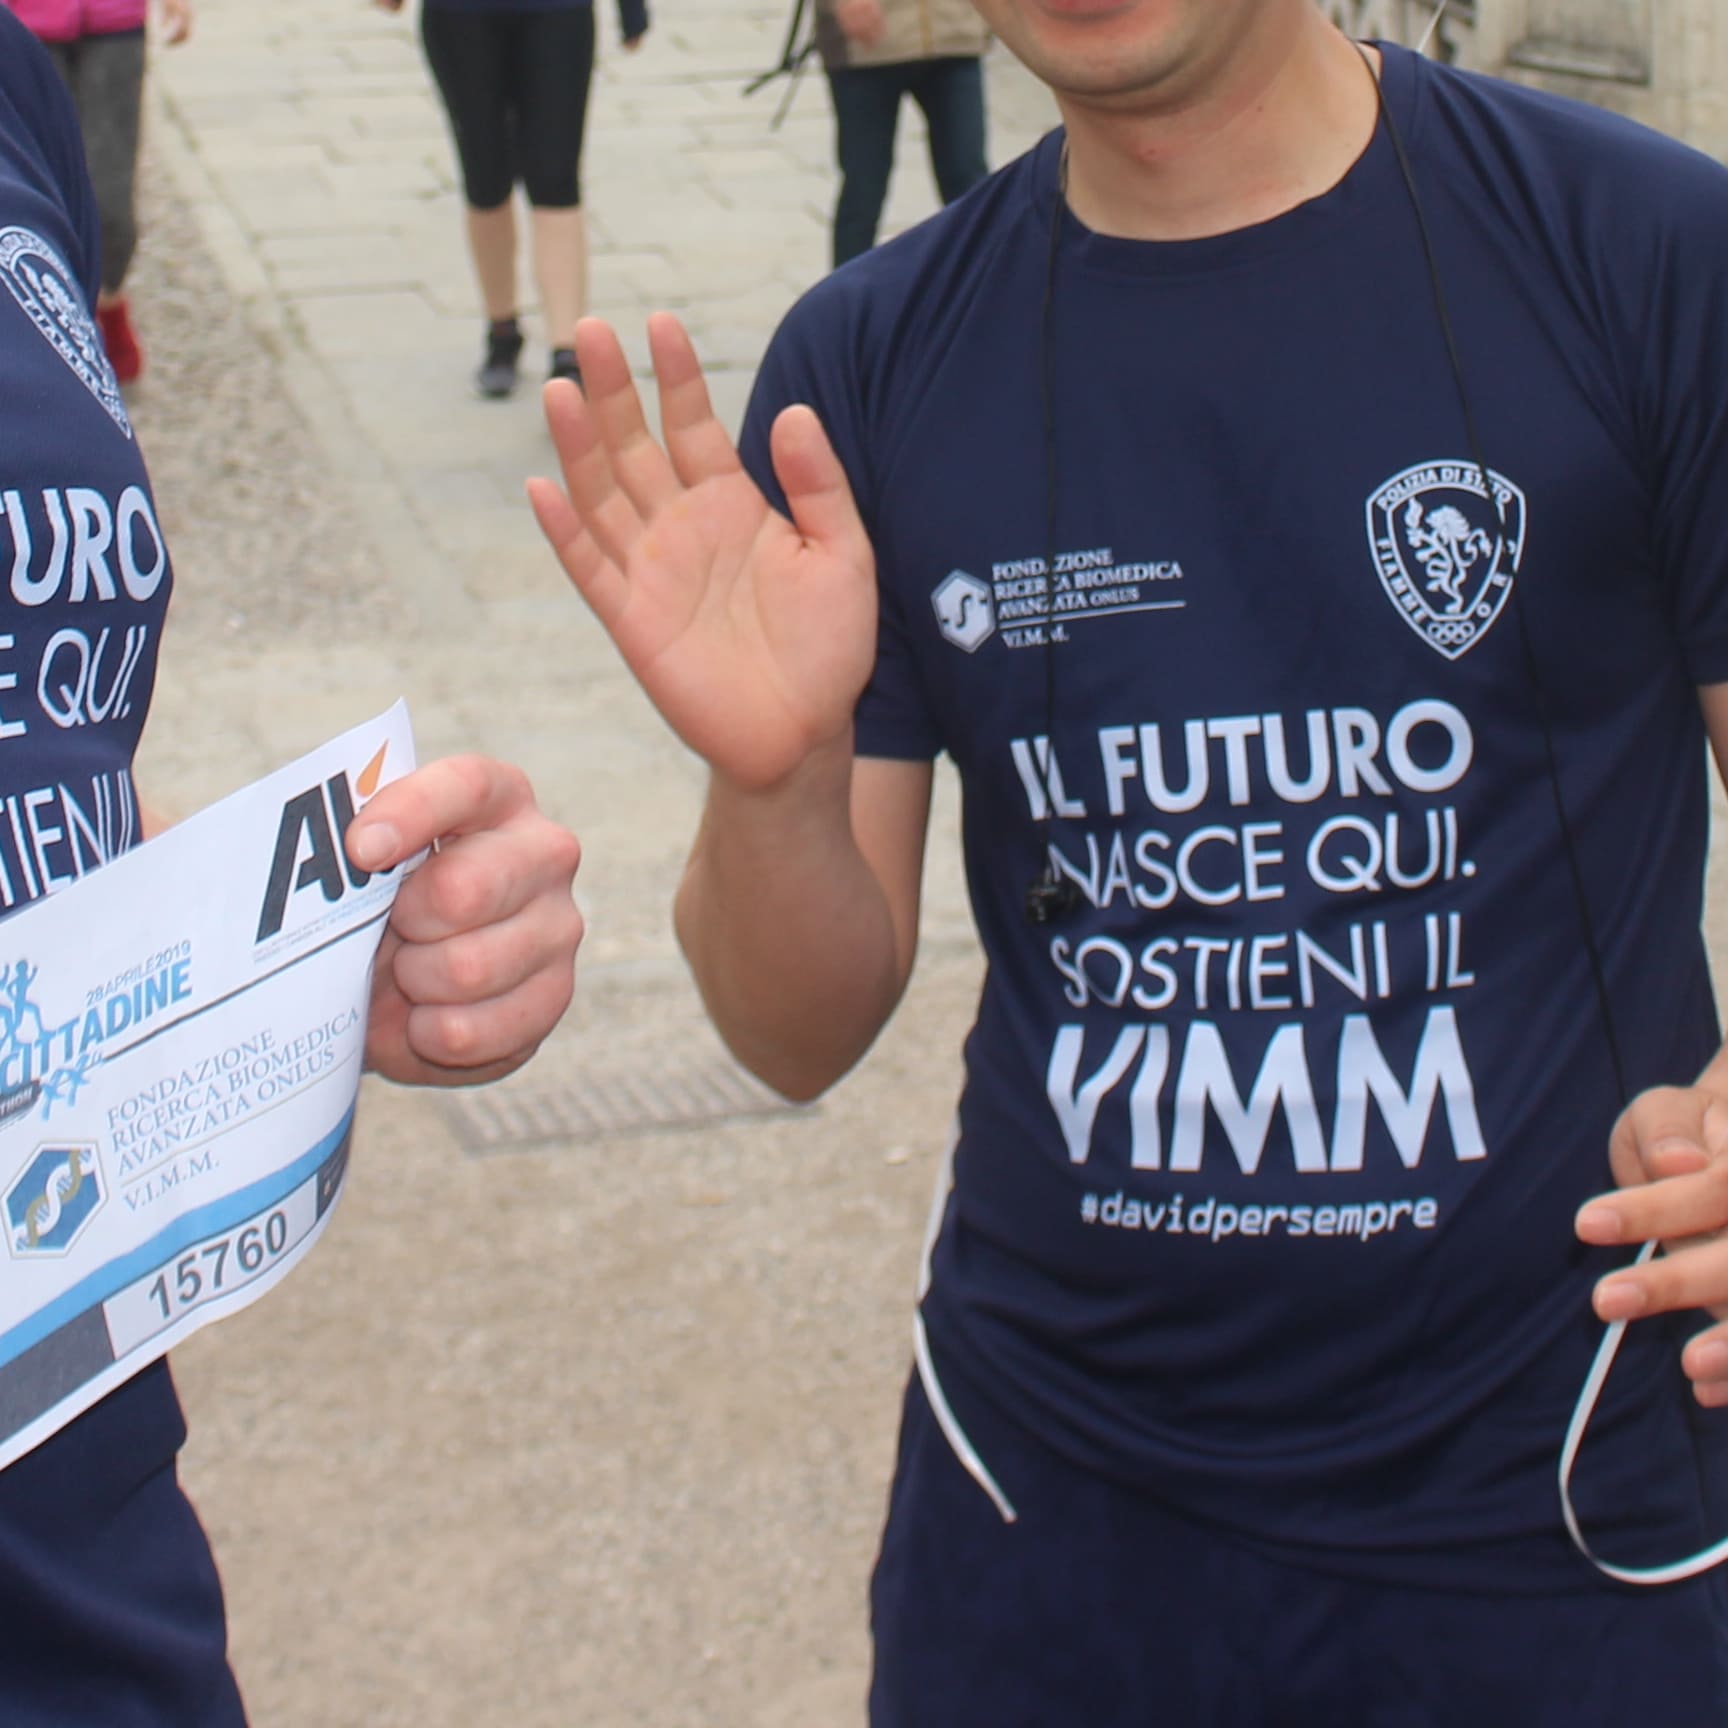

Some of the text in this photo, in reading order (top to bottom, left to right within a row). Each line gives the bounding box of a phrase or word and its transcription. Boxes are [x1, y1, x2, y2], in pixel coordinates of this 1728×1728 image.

[1377, 467, 1513, 512] POLIZIA DI STTO
[992, 547, 1114, 581] FONDZIONE
[1074, 561, 1183, 589] BIOMEDICA
[37, 626, 146, 728] QUI.
[1010, 697, 1473, 821] IL FUTURO
[1044, 806, 1476, 910] NASCE QUI.
[1050, 912, 1475, 1011] SOSTIENI IL
[107, 1031, 275, 1130] FONDAZIONE
[111, 1006, 359, 1153] RICERCA BIOMEDICA
[118, 1095, 251, 1176] AVANZATA
[256, 1043, 335, 1103] ONLUS
[1046, 1005, 1487, 1175] VIMM
[124, 1150, 220, 1212] V.I.M.M.
[1080, 1190, 1438, 1243] #davidpersempre
[149, 1210, 287, 1319] 15760
